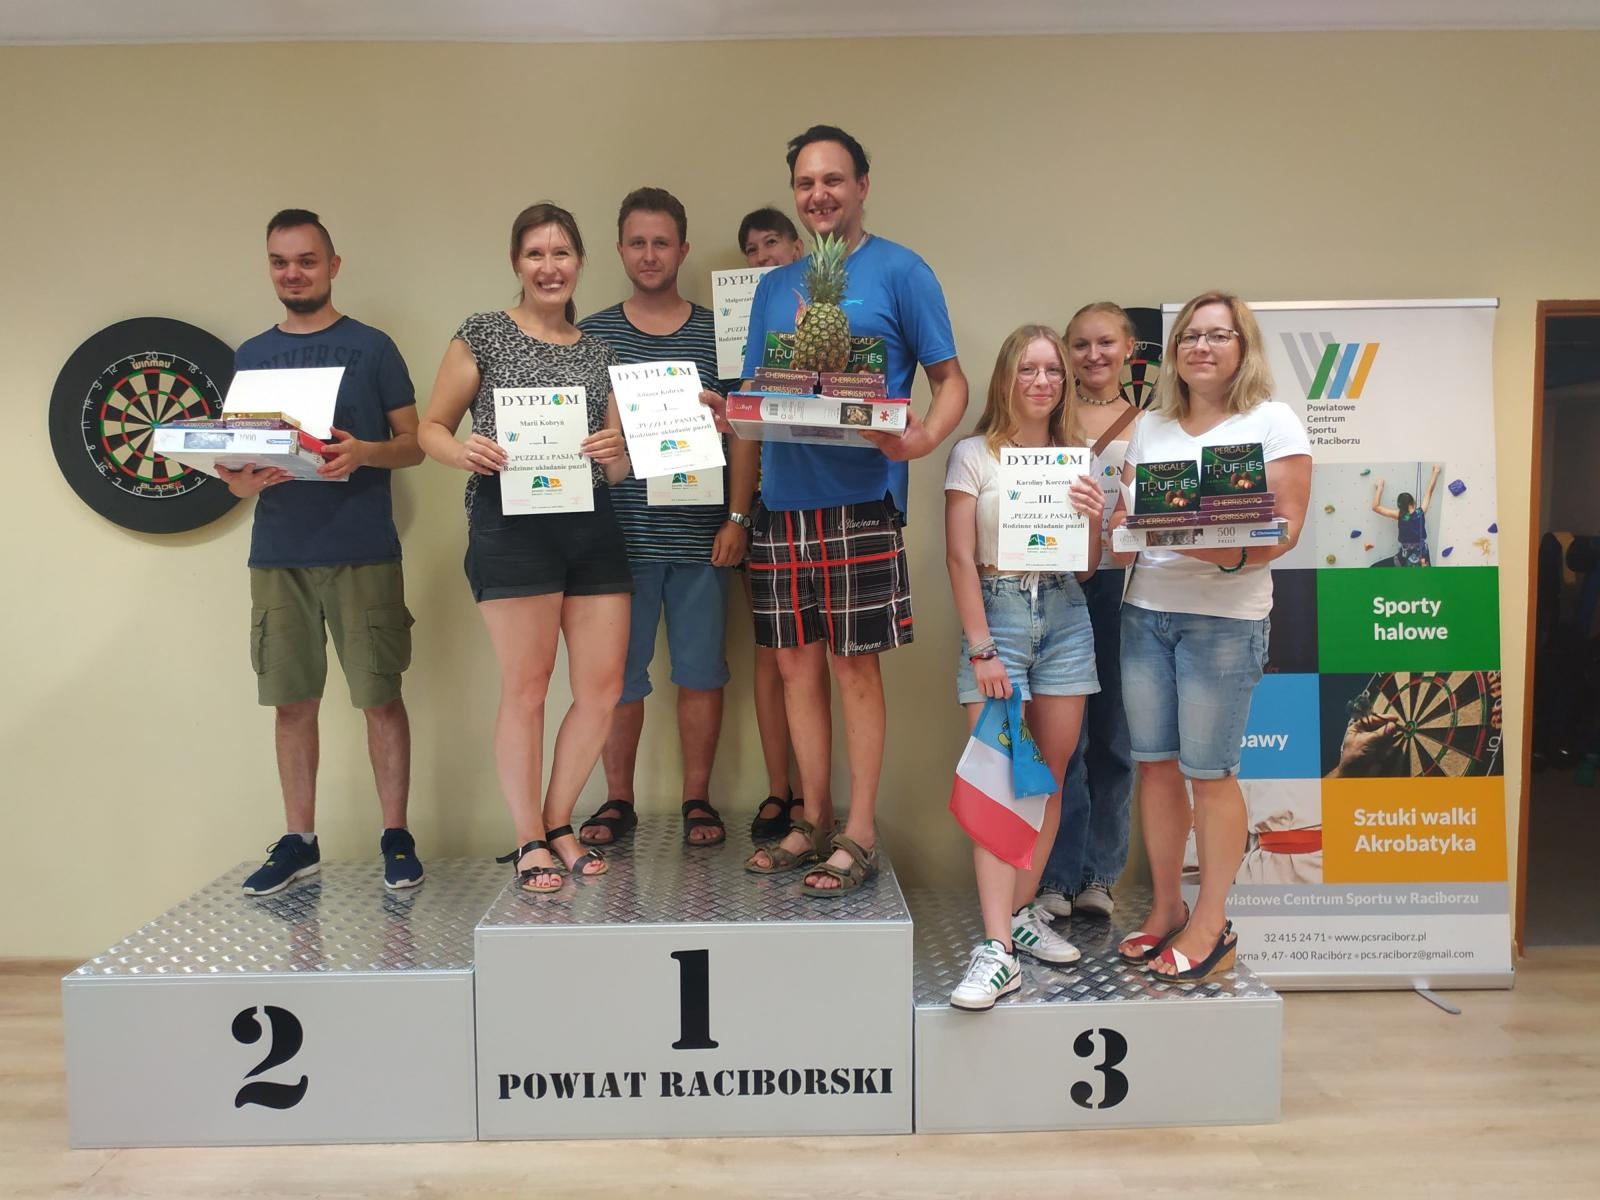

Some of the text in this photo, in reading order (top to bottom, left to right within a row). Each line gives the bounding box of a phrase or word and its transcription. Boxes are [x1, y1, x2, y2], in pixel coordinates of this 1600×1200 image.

[717, 272, 765, 286] DYPL
[145, 351, 159, 360] 20
[848, 352, 883, 364] UFFLES
[132, 360, 171, 370] WINMAU
[501, 393, 580, 406] DYPLOM
[1306, 404, 1356, 412] Powiatowe
[1306, 415, 1346, 423] Centrum
[1307, 426, 1337, 435] Sportu
[1317, 436, 1360, 444] Raciborzu
[1214, 445, 1252, 454] PERGALE
[1007, 453, 1084, 466] DYPLOM
[1148, 462, 1187, 472] PERGALE
[1205, 460, 1264, 475] TRUFFLES
[1139, 478, 1198, 493] TRUFFLES
[1038, 494, 1052, 504] III
[1217, 527, 1236, 537] 500
[1372, 596, 1442, 618] Sporty
[1374, 622, 1448, 640] halowe
[1354, 808, 1477, 827] Sztuki walki
[1354, 834, 1476, 855] Akrobatyka
[1225, 892, 1479, 906] wiatowe Centrum Sportu w Raciborzu
[1264, 932, 1426, 942] 32 415 24 71 www.pcsraciborz.pl
[1236, 952, 1259, 960] orna
[1261, 952, 1270, 961] 9,
[1311, 950, 1352, 960] Racibórz
[1360, 948, 1474, 960] pcs.raciborz@gmail.com
[670, 949, 719, 1050] 1
[231, 1005, 308, 1109] 2
[1070, 1028, 1129, 1110] 3
[497, 1068, 893, 1099] POWIAT RACIBORSKI
